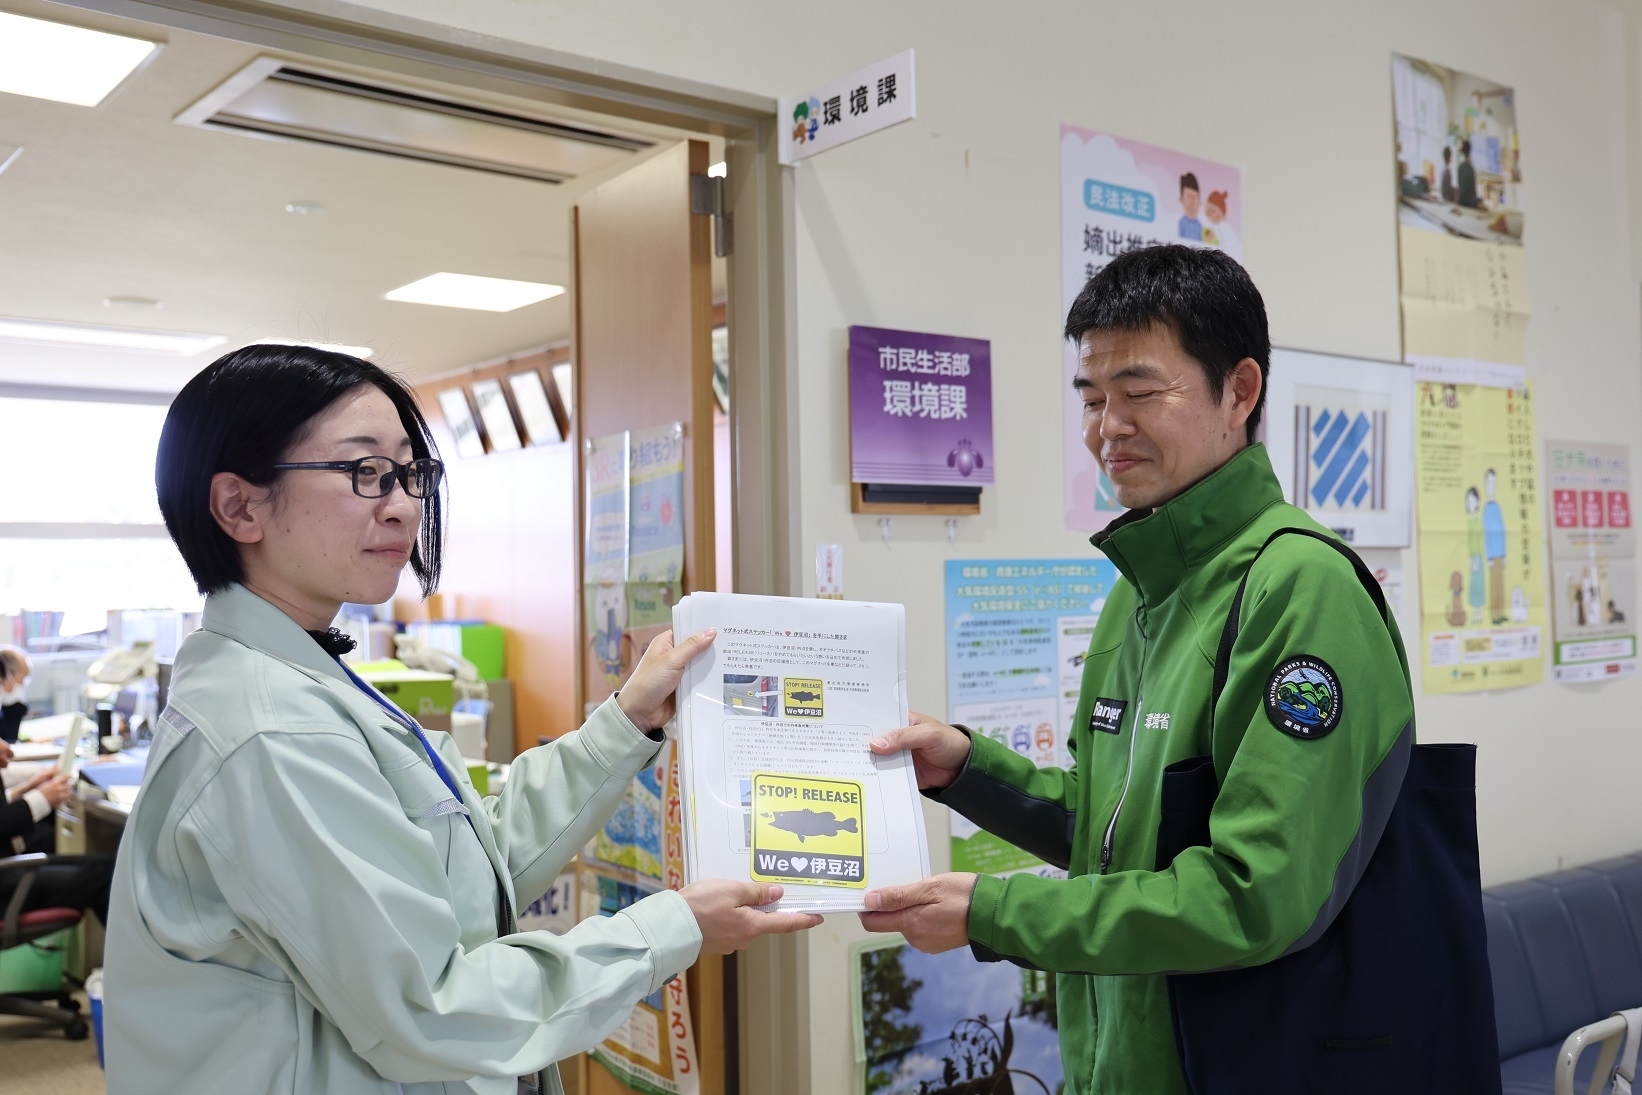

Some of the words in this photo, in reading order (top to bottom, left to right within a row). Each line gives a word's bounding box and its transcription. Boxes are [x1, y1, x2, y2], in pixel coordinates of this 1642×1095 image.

[822, 73, 897, 126] 環境課
[1089, 184, 1151, 217] 民法改正
[878, 346, 971, 377] 市民生活部
[883, 380, 968, 420] 環境課
[1269, 674, 1282, 707] NATIONAL
[1280, 661, 1301, 675] PARKS
[1308, 661, 1333, 681] WILDLIFE
[1323, 681, 1339, 728] CONSERVATION
[804, 708, 822, 716] 伊豆沼
[1093, 701, 1122, 723] Ranger
[1144, 712, 1171, 730] 環境省
[759, 784, 797, 799] STOP!
[802, 788, 859, 804] RELEASE
[758, 854, 790, 871] We
[810, 857, 860, 877] 伊豆沼
